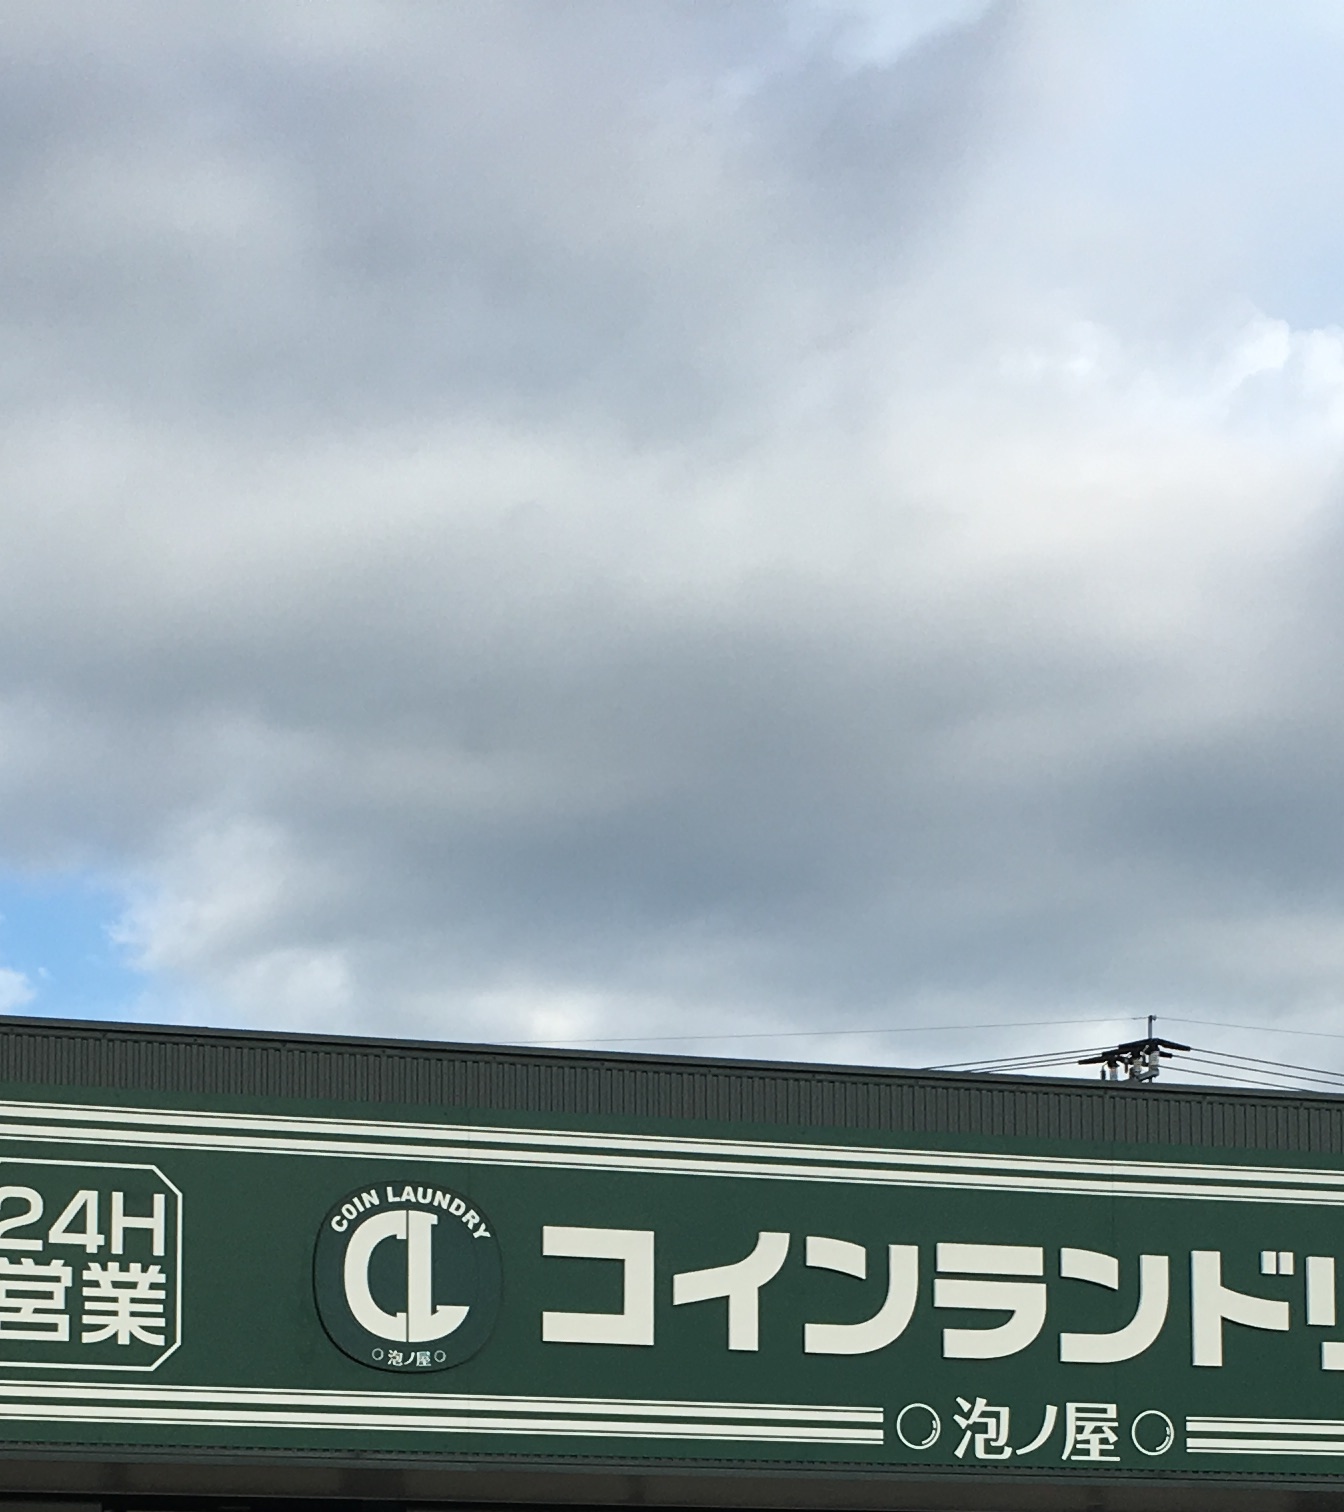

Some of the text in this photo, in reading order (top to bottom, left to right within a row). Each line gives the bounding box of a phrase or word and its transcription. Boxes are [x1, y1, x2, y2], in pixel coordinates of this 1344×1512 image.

[329, 1184, 493, 1241] COIN LAUNDRY
[952, 1396, 1121, 1462] 泡ノ屋
